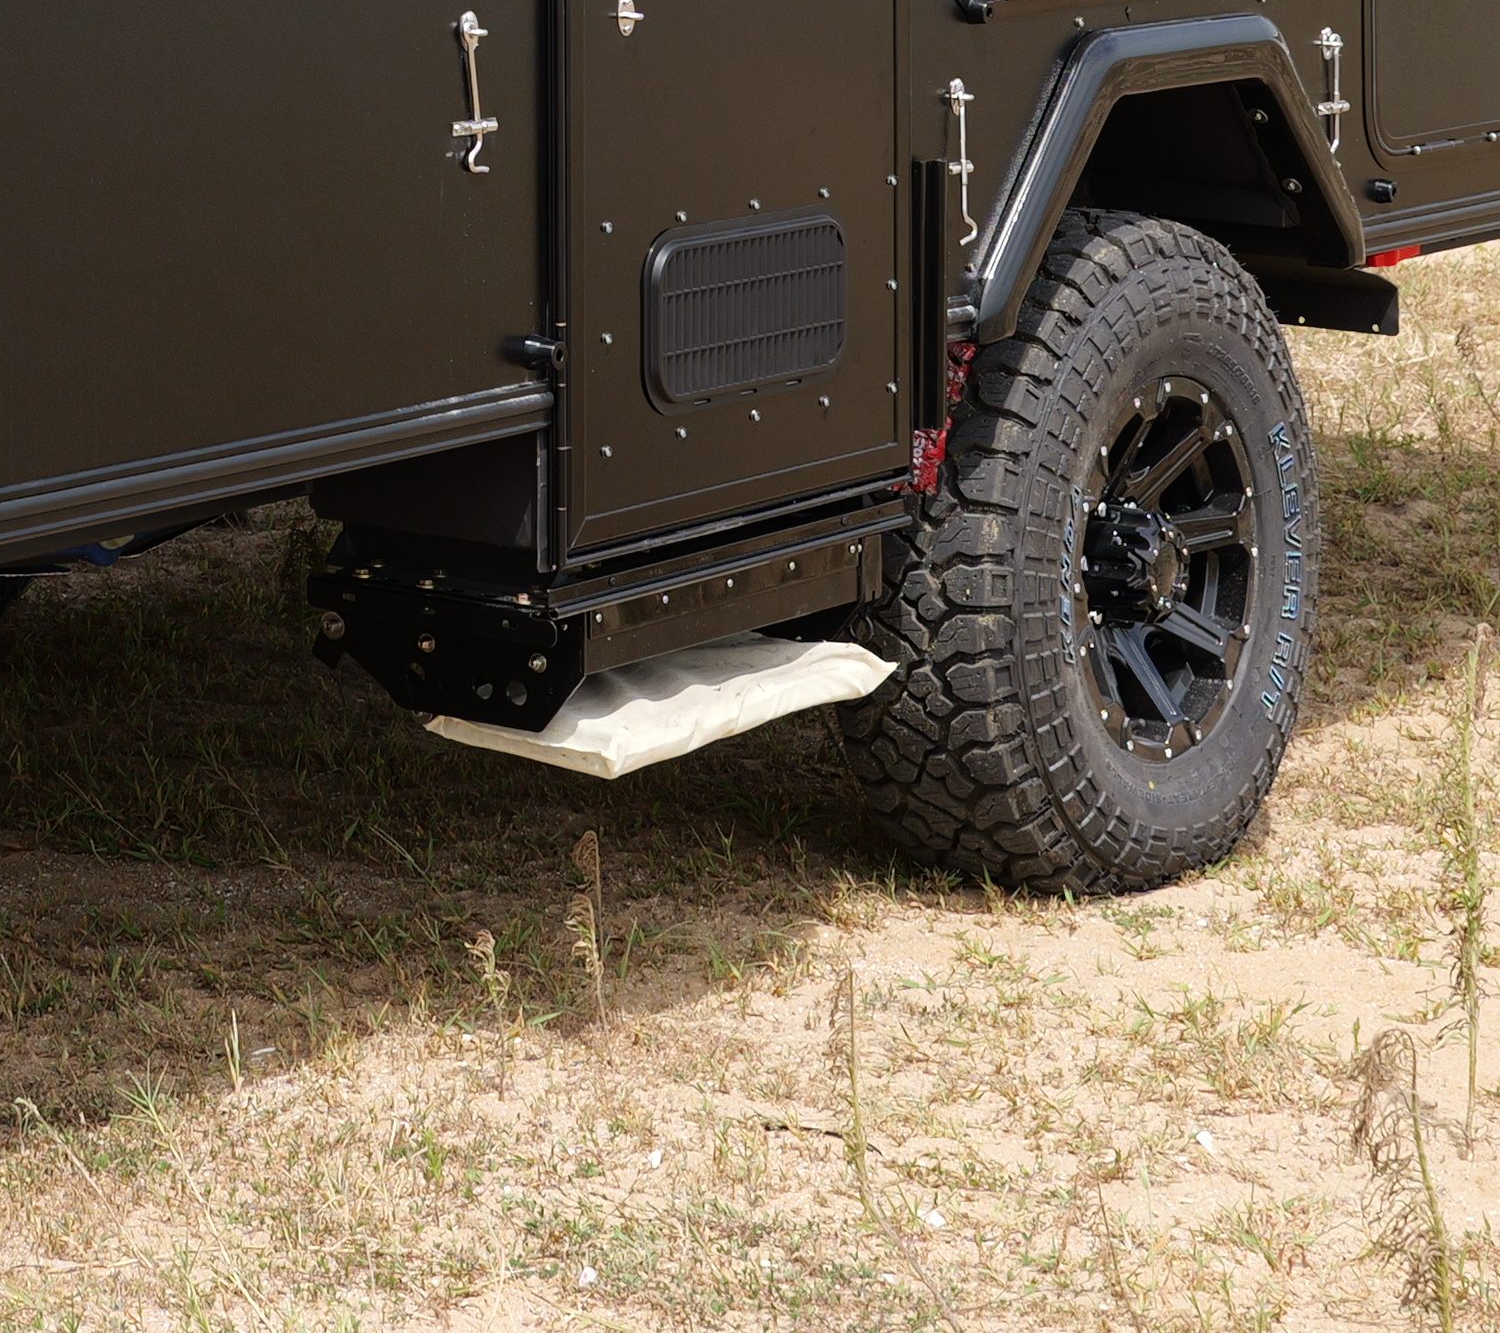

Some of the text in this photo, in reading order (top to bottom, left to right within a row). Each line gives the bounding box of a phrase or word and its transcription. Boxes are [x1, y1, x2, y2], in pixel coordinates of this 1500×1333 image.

[1059, 484, 1082, 665] KENDA
[1260, 421, 1302, 722] KLEVER R/T
